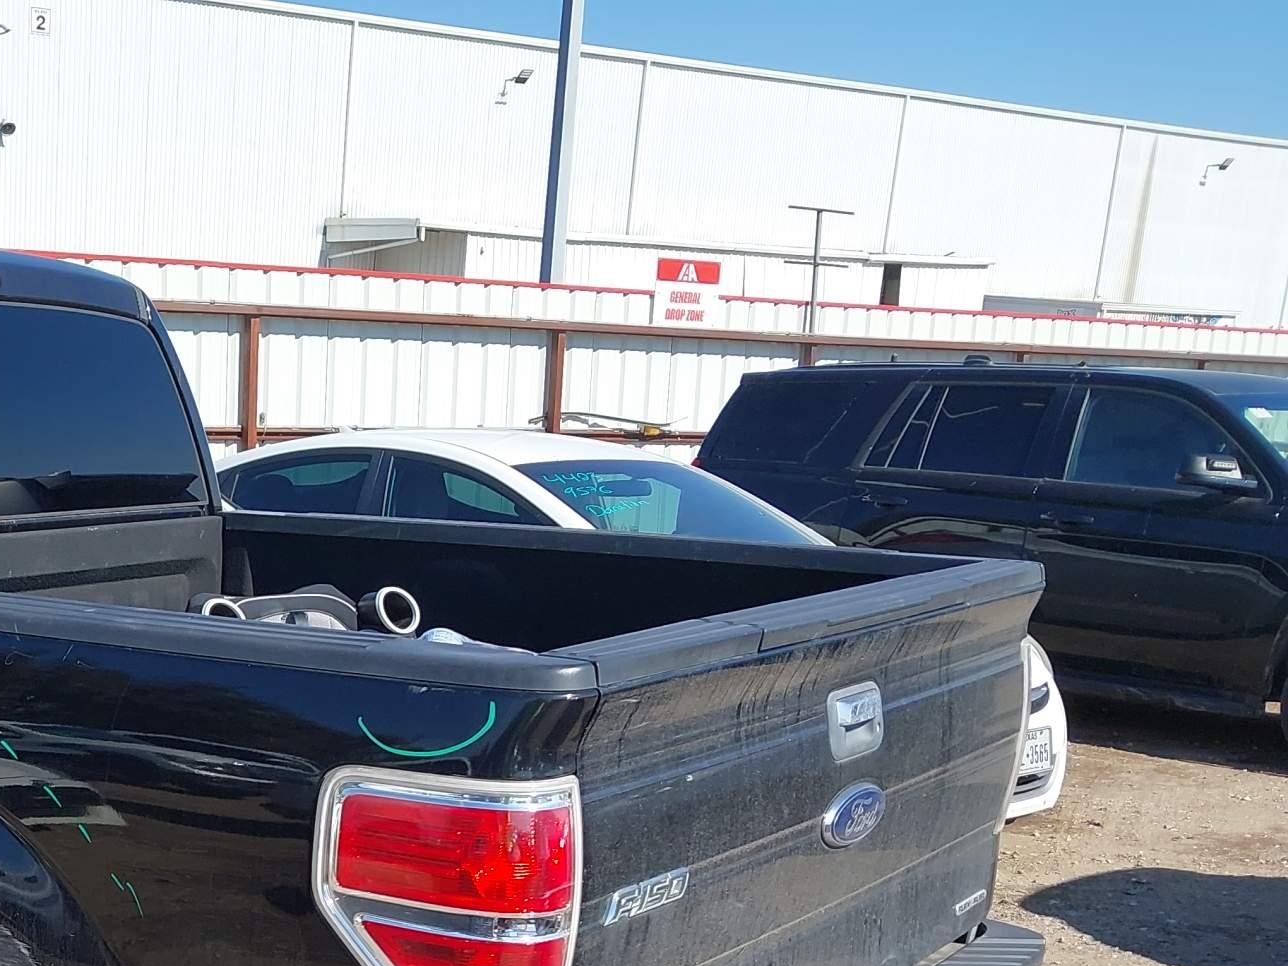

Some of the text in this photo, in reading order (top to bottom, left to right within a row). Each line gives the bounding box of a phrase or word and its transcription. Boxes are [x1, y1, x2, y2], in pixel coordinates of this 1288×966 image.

[36, 15, 46, 31] 2
[669, 290, 701, 304] GENERAL
[664, 308, 705, 322] DROP ZONE
[845, 797, 880, 836] Ford
